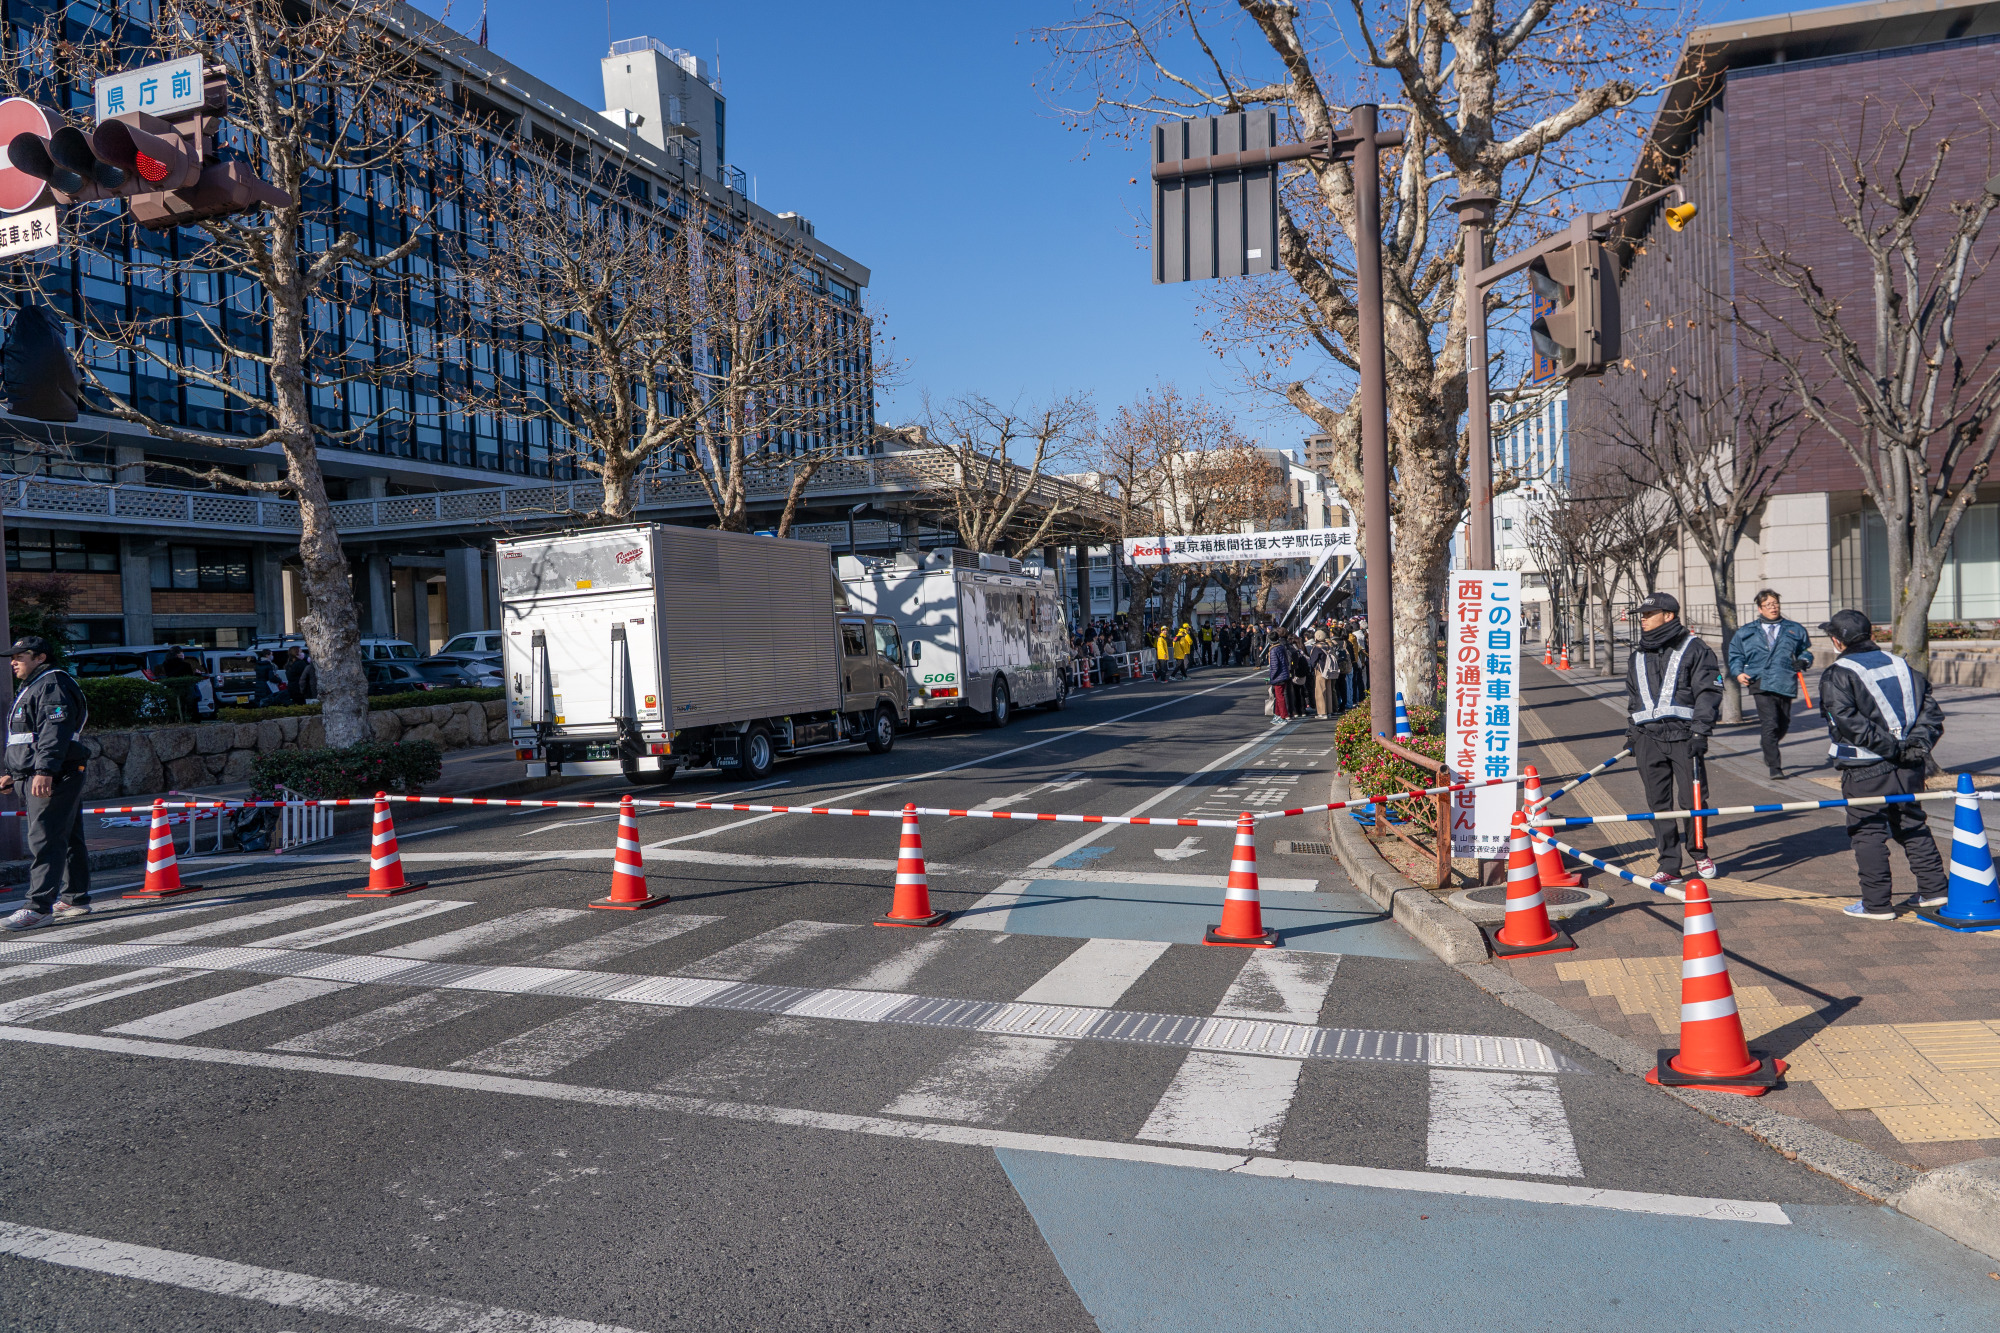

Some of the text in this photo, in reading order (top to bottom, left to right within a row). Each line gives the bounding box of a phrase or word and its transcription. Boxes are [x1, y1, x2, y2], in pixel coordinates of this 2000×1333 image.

[107, 69, 192, 115] 県庁前
[1174, 532, 1351, 553] 東京箱根間往復大学駅伝競走
[924, 673, 955, 683] 506
[1485, 582, 1512, 777] この自転車通行帯
[1454, 580, 1482, 830] 西行きの通行はできません
